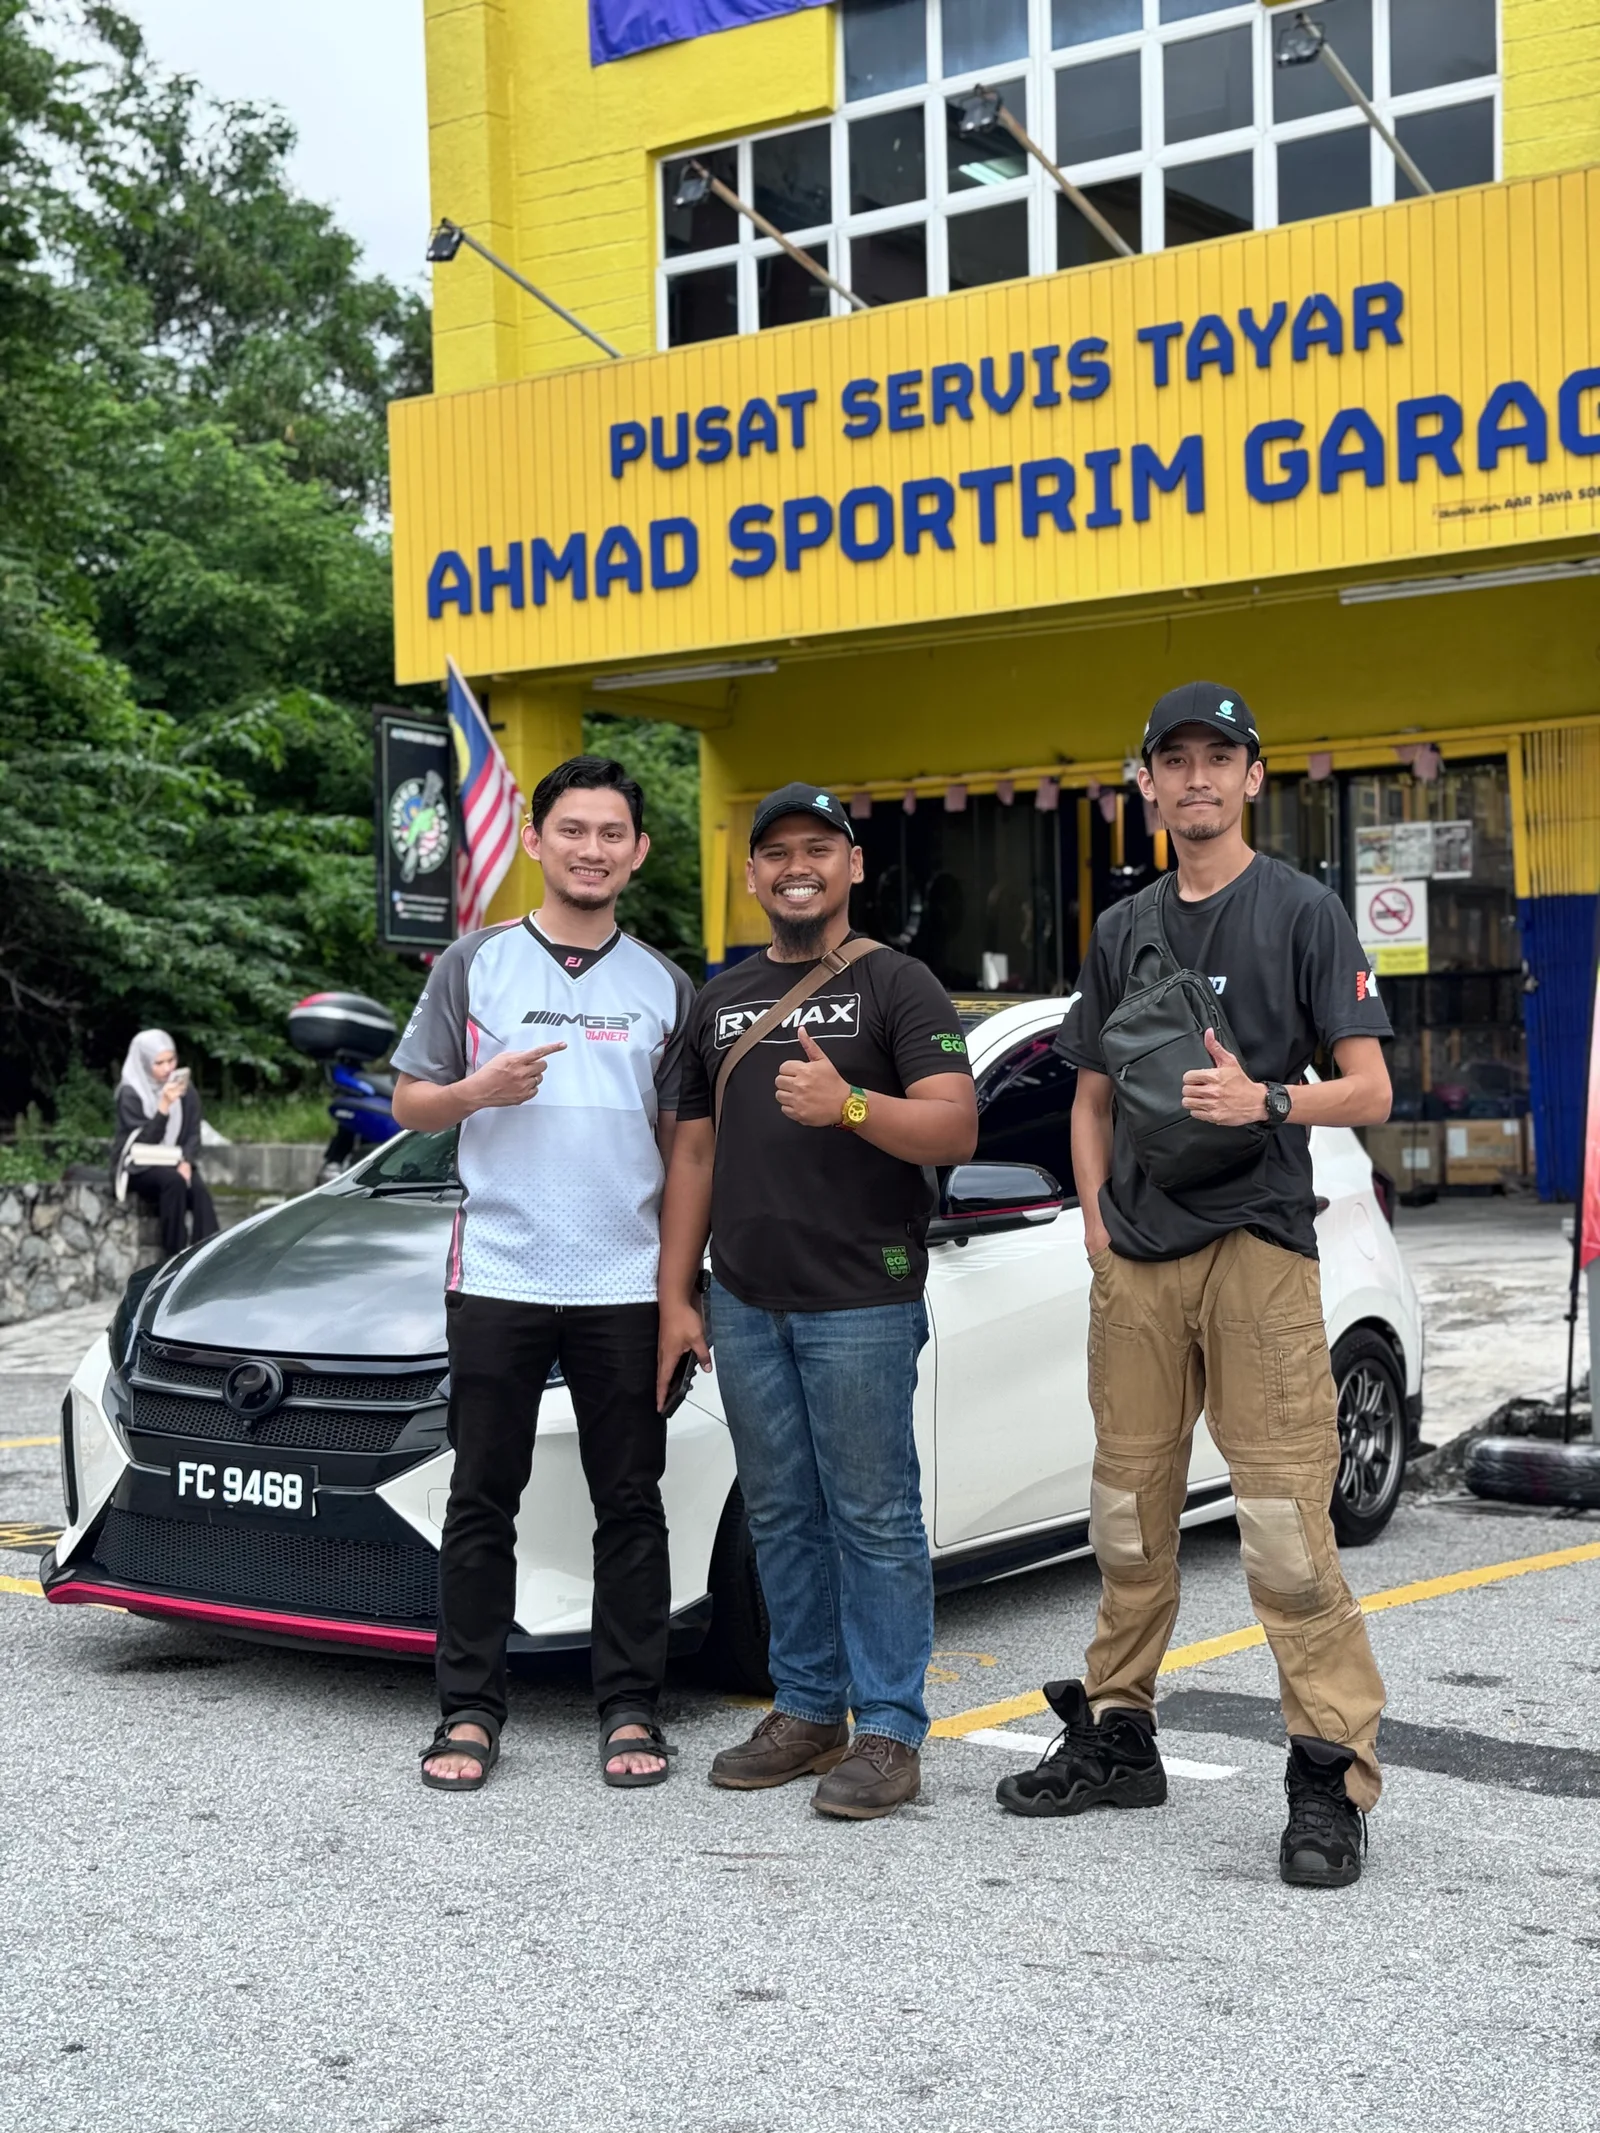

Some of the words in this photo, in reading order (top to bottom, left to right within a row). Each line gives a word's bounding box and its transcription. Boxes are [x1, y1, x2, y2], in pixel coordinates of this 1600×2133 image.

[611, 388, 817, 478] PUSAT
[842, 336, 1112, 439] SERVIS
[1137, 281, 1404, 388] TAYAR
[1504, 496, 1533, 509] AAR
[1538, 490, 1573, 506] JAYA
[427, 517, 699, 619] AHMAD
[729, 434, 1205, 578] SPORTRIM
[585, 1029, 629, 1042] OWNER
[930, 1033, 961, 1041] APOLLO
[941, 1039, 966, 1054] eco
[178, 1461, 216, 1499] FC
[222, 1466, 303, 1510] 9468
